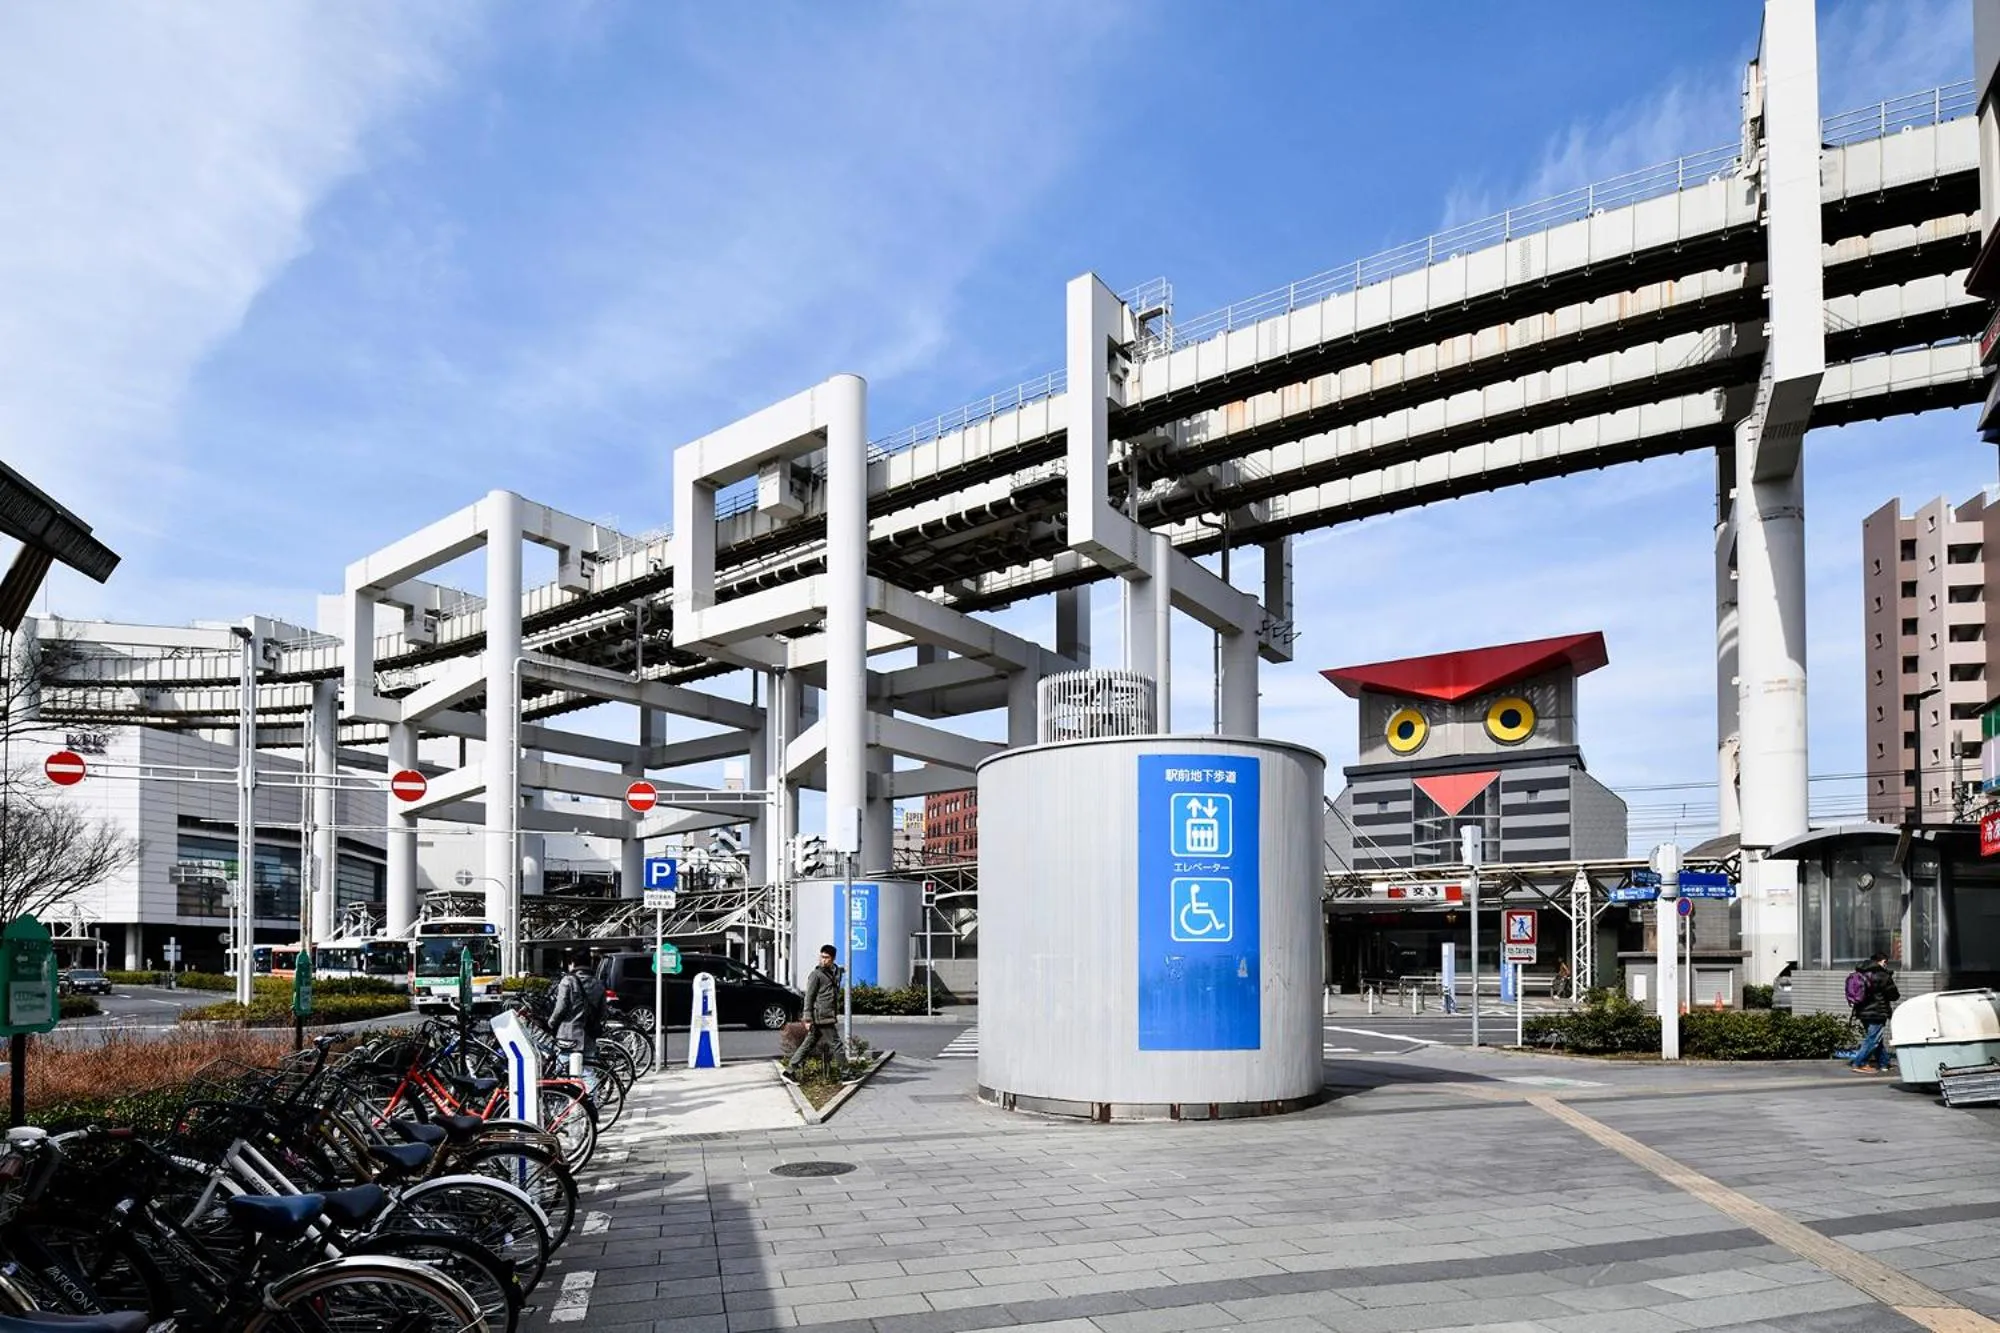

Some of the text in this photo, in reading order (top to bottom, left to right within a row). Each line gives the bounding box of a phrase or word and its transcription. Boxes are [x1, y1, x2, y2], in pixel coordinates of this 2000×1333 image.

[1165, 769, 1237, 783] 駅前地下歩道
[652, 862, 671, 885] P
[1174, 863, 1231, 872] エレベーター
